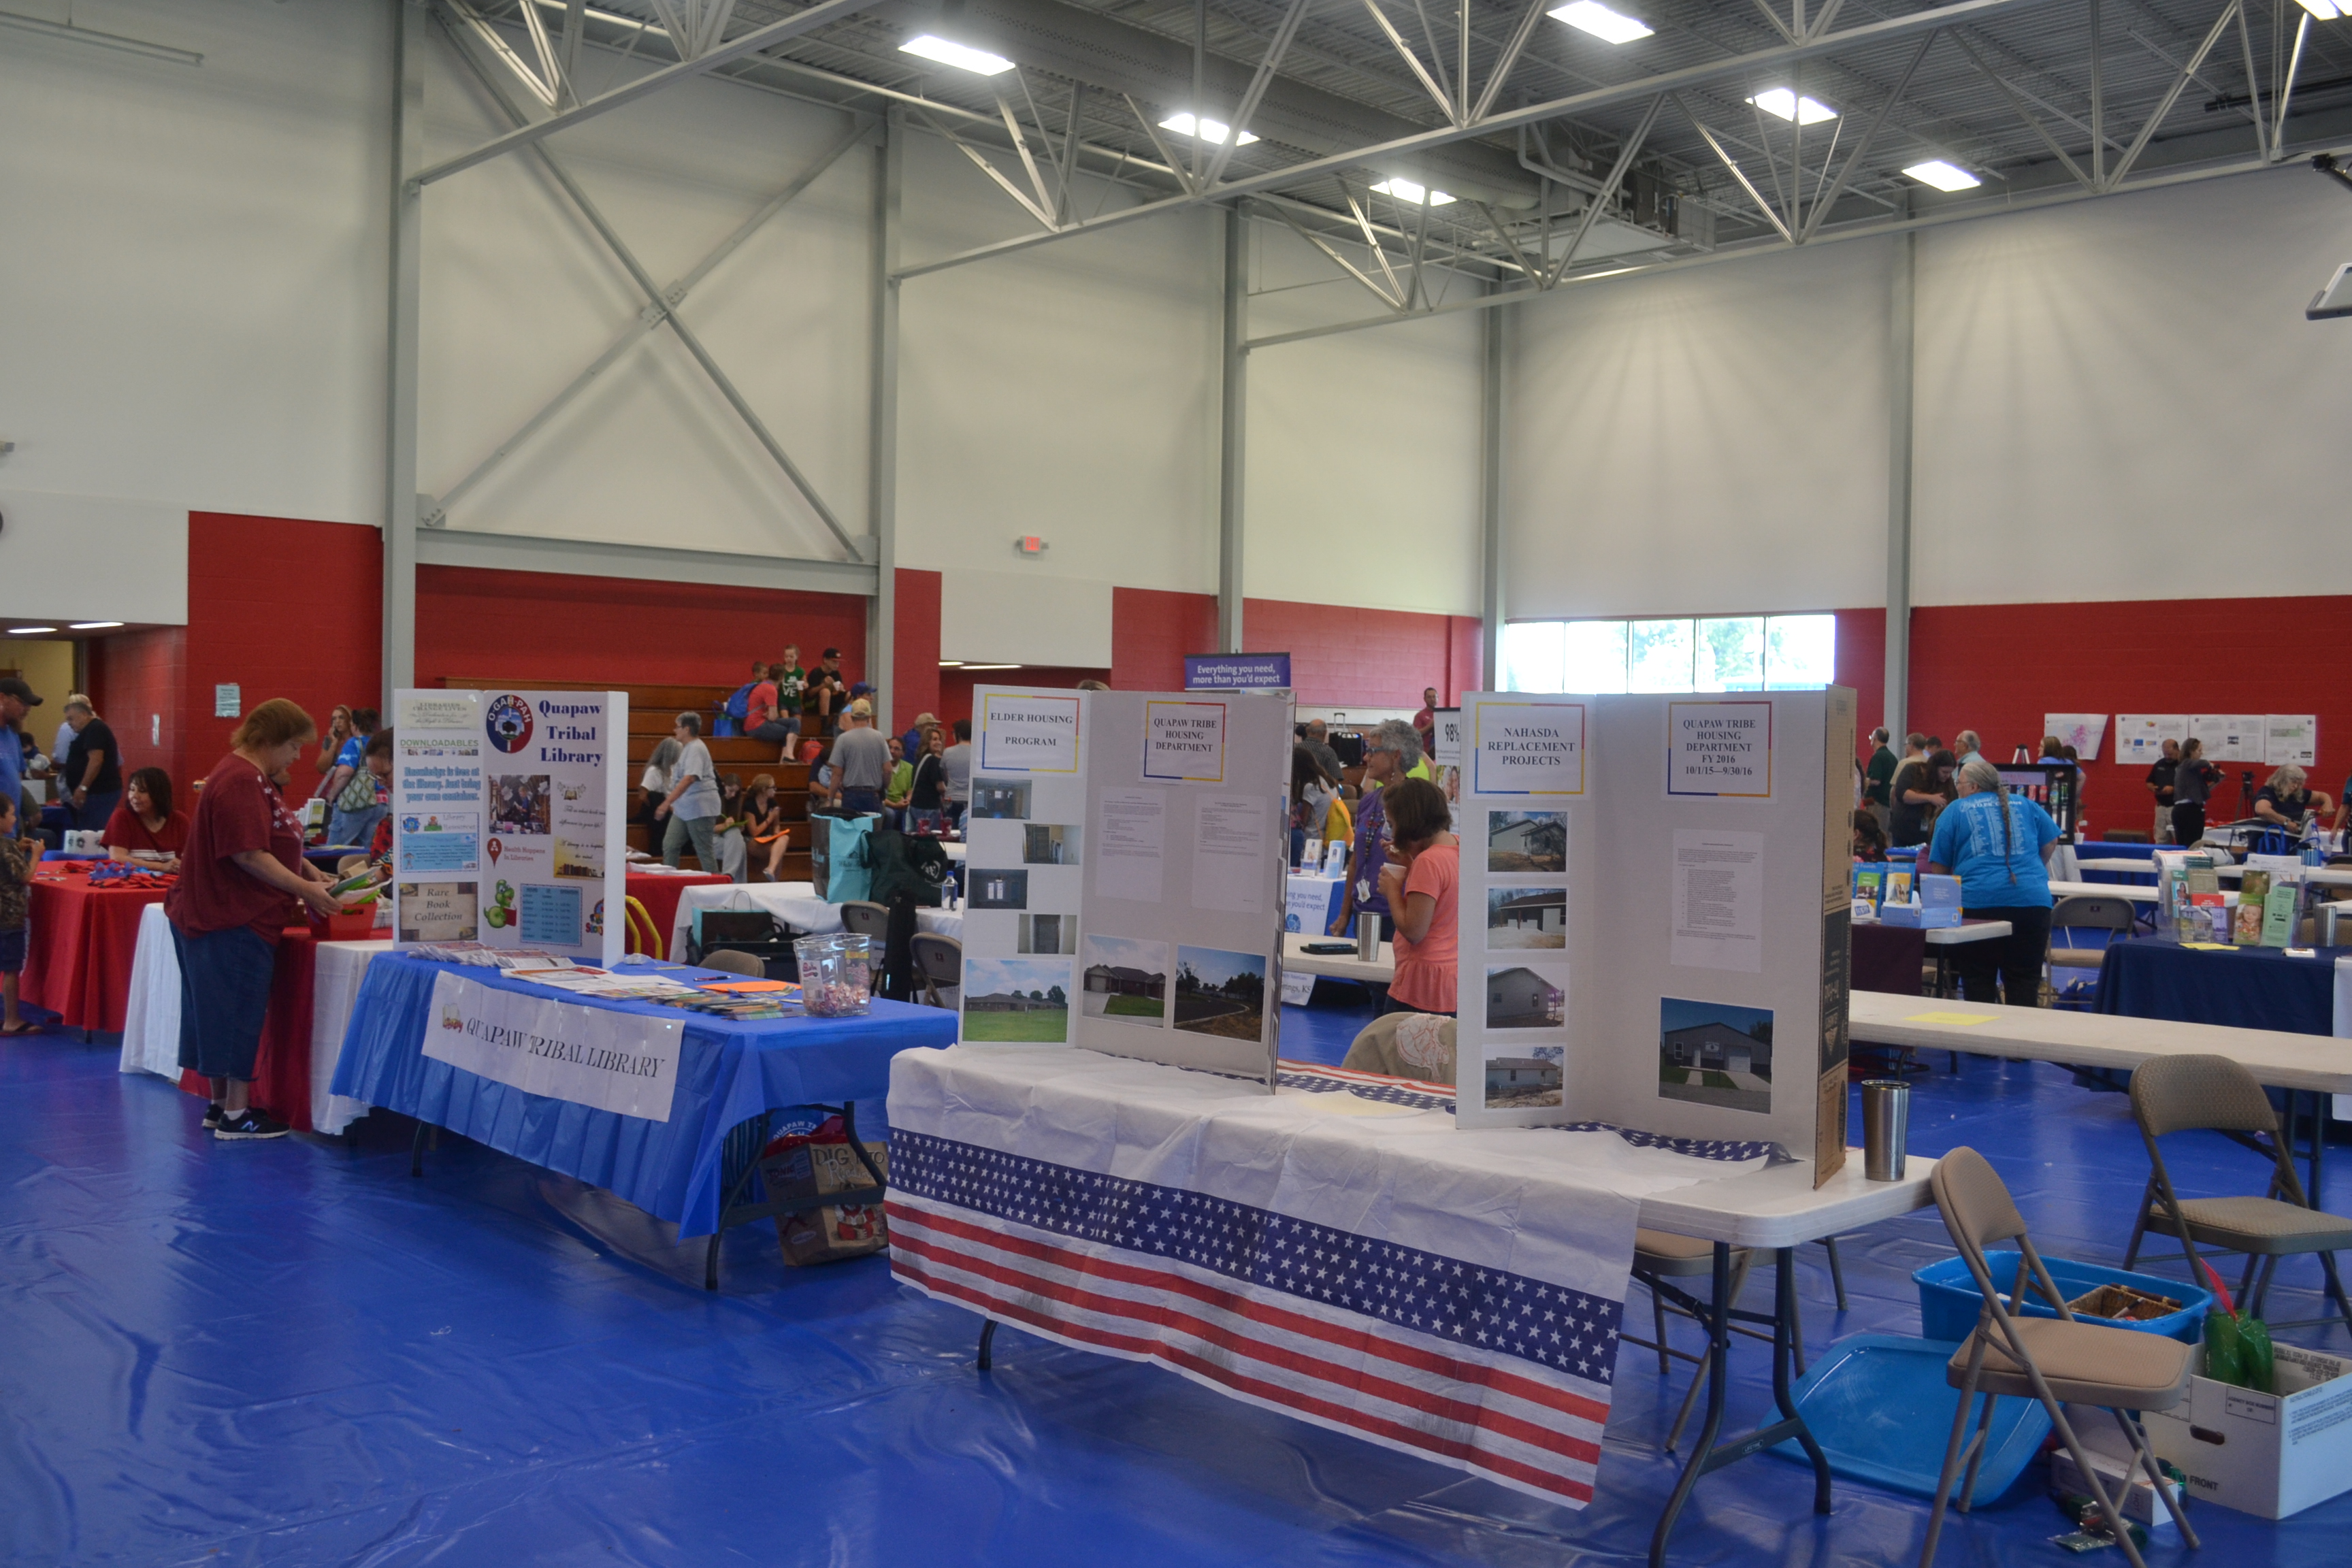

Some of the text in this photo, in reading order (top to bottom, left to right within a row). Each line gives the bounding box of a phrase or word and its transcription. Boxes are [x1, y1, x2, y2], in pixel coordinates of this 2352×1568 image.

[1197, 664, 1275, 675] Everything you need,
[1213, 675, 1231, 683] than
[1232, 674, 1253, 685] you'd
[1254, 674, 1280, 685] expect
[539, 700, 602, 718] Quapaw
[990, 712, 1073, 724] ELDER HOUSING
[1154, 718, 1217, 728] QUAPAW TRIBE
[1683, 719, 1755, 730] QUAPAW TRIBE
[546, 725, 595, 740] Tribal
[1165, 730, 1204, 740] HOUSING
[1445, 723, 1459, 742] 98%
[1504, 728, 1559, 738] NAHASDA
[1697, 732, 1741, 740] HOUSING
[1005, 736, 1056, 746] PROGRAM
[1156, 741, 1213, 752] DEPARTMENT
[1488, 741, 1575, 751] REPLACEMENT
[1686, 742, 1752, 751] DEPARTMENT
[540, 747, 602, 767] Library
[1502, 755, 1561, 766] PROJECTS
[1702, 755, 1735, 763] FY 2016
[404, 766, 446, 778] Knowledge
[402, 779, 415, 789] the
[427, 888, 449, 897] Rare
[426, 900, 451, 909] Book
[1306, 902, 1325, 911] expect
[414, 913, 462, 921] Collection
[466, 1017, 666, 1078] QUAPAW TRIBAL LIBRARY
[813, 1148, 849, 1166] DIG
[2189, 1475, 2219, 1491] FRONT
